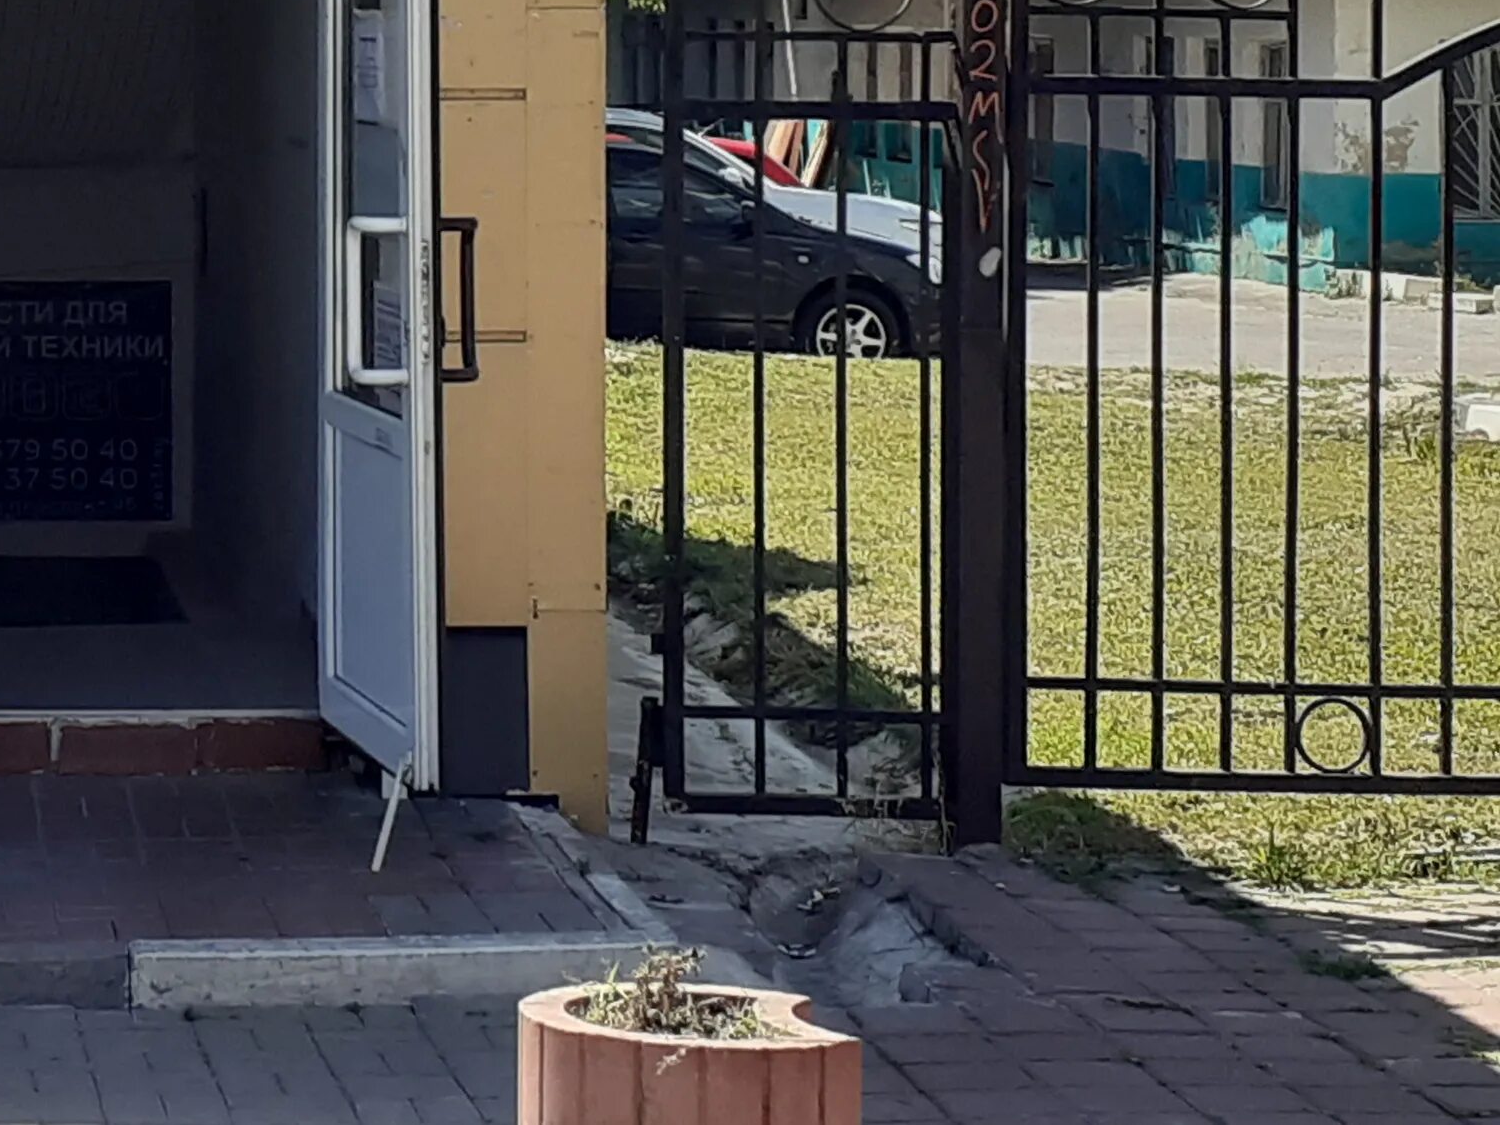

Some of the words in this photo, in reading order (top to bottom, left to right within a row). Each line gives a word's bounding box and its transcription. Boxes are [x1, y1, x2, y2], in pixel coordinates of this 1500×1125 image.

[22, 334, 164, 359] ТЕХНИКИ
[51, 438, 89, 461] 50
[99, 438, 138, 461] 40
[4, 467, 41, 490] 37
[50, 467, 89, 490] 50
[99, 467, 138, 490] 40
